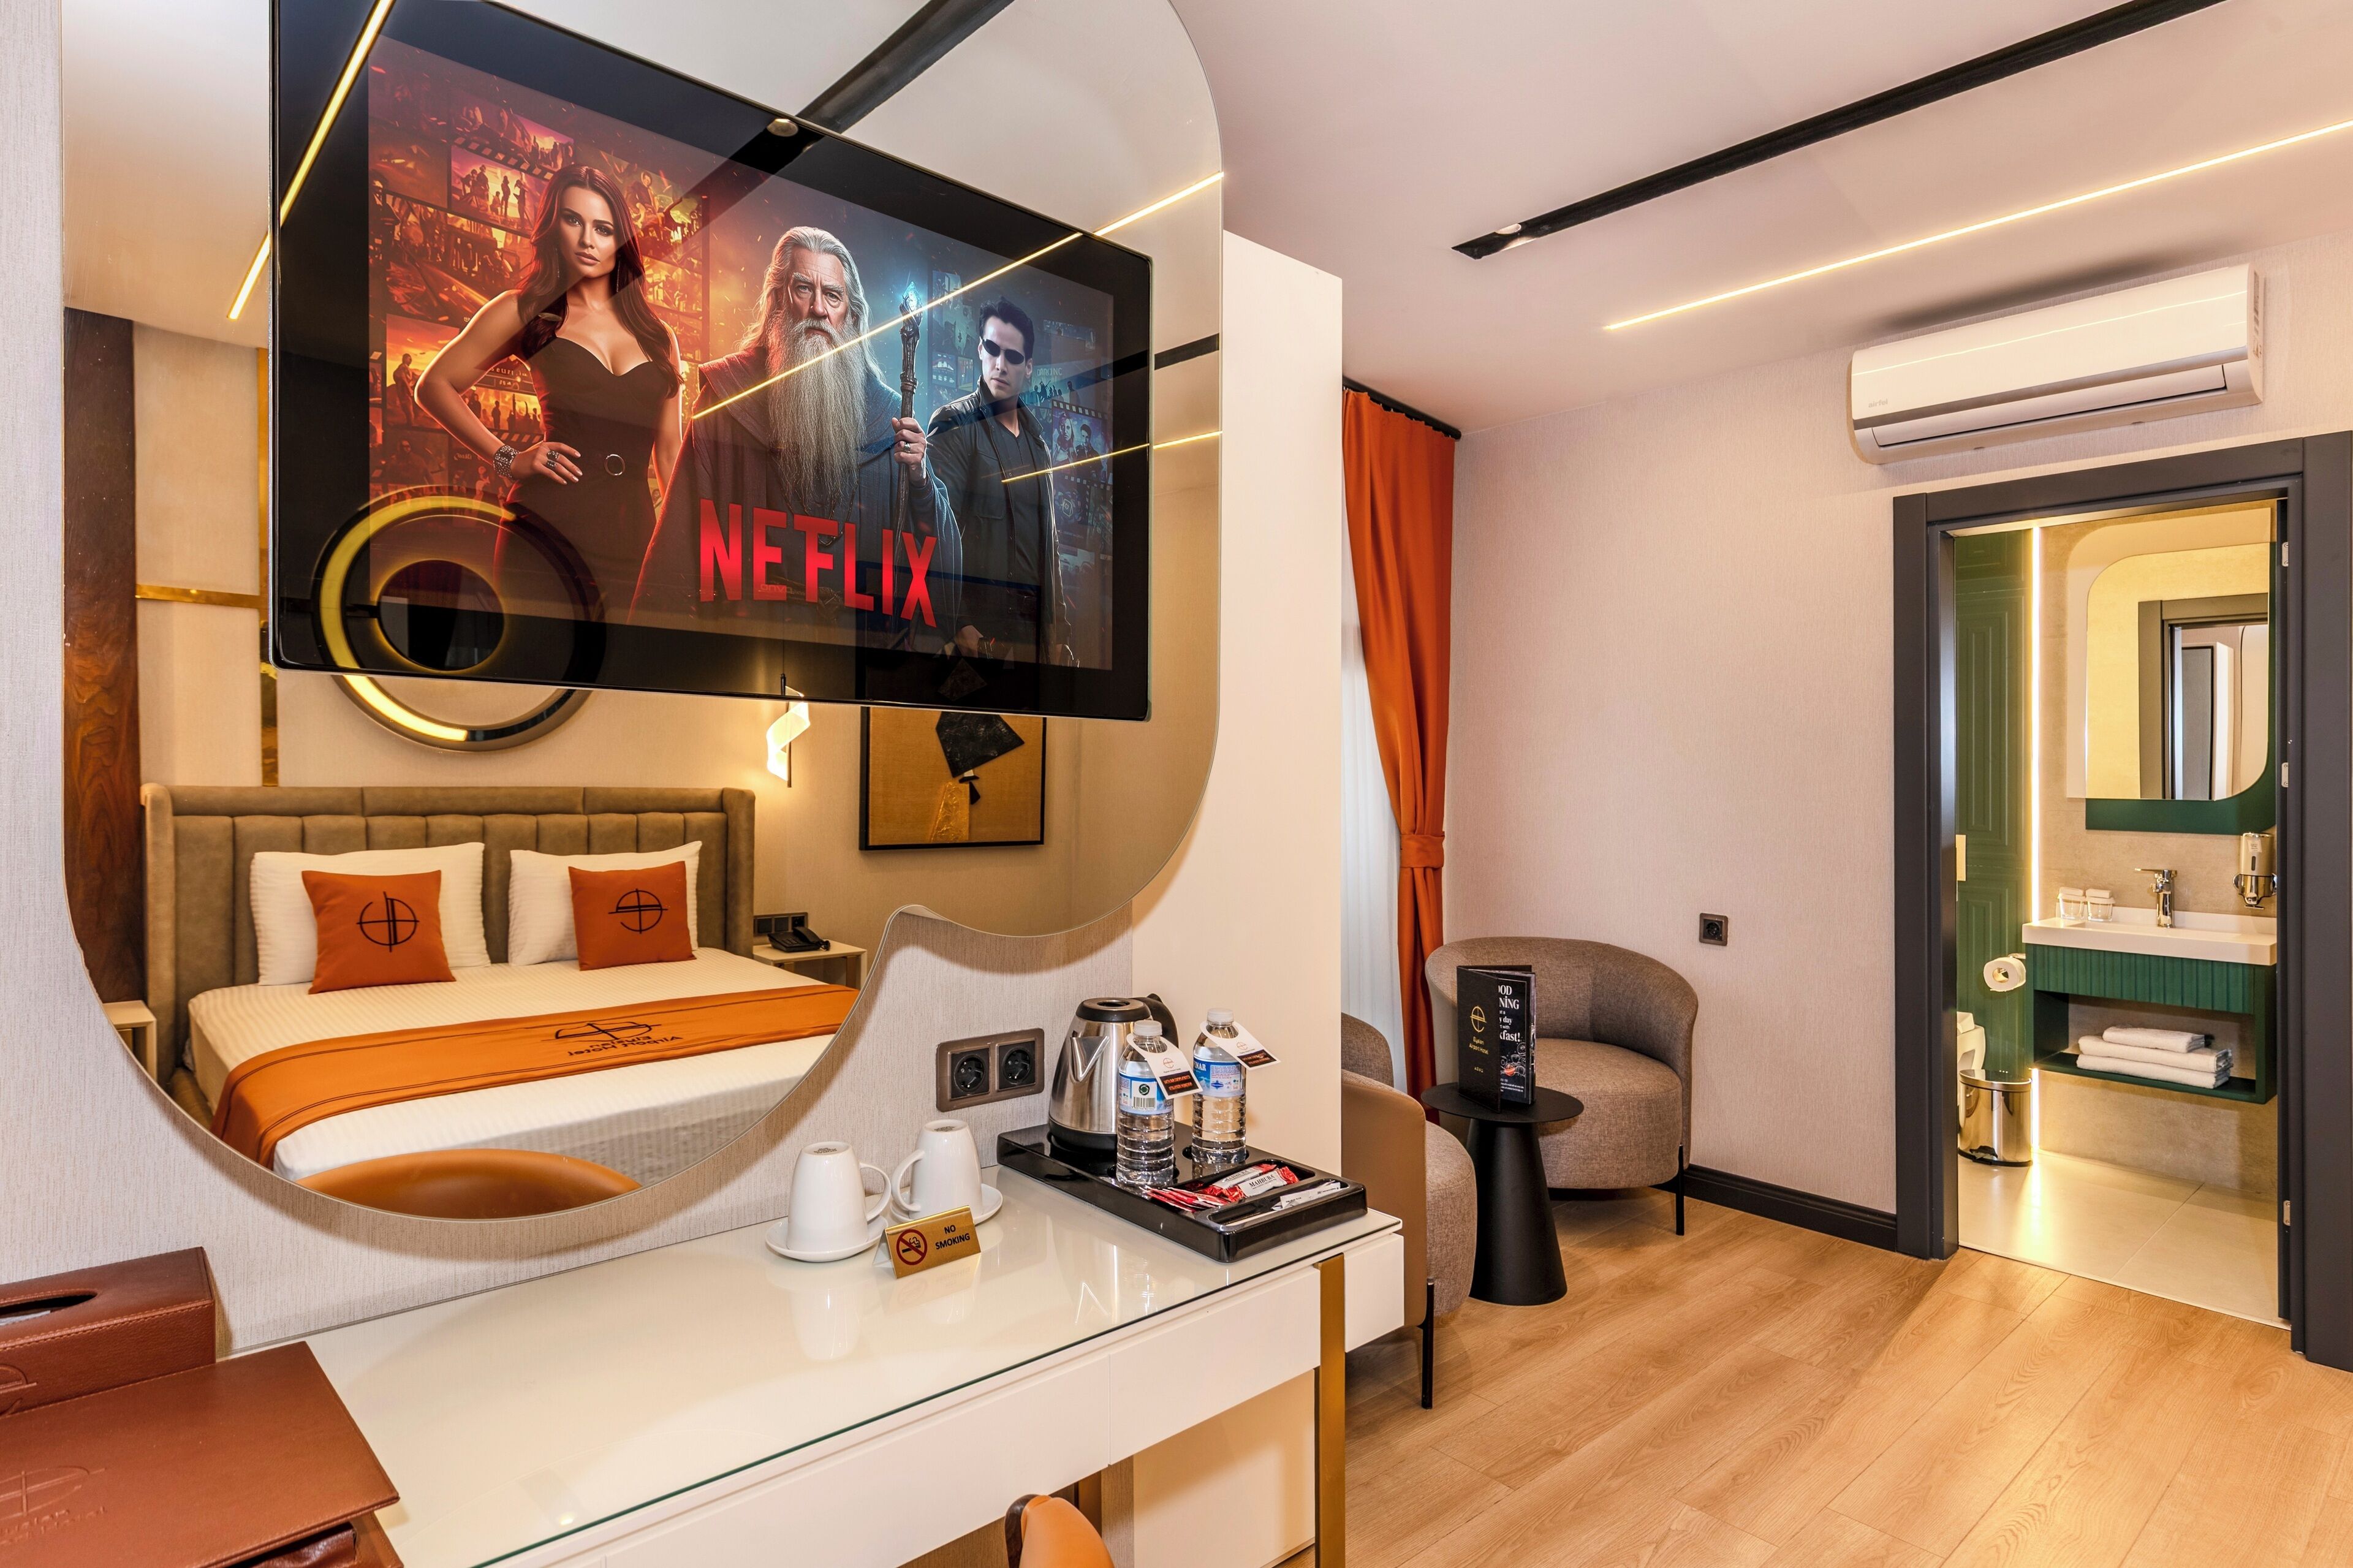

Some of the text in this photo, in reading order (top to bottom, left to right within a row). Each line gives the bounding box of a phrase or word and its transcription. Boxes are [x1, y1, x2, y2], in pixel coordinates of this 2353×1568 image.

[1868, 398, 1888, 407] airfel
[1498, 985, 1512, 996] OD
[1502, 1016, 1513, 1026] day
[1249, 1174, 1275, 1187] MAHBUBA
[944, 1224, 956, 1234] NO
[935, 1233, 970, 1250] SMOKING
